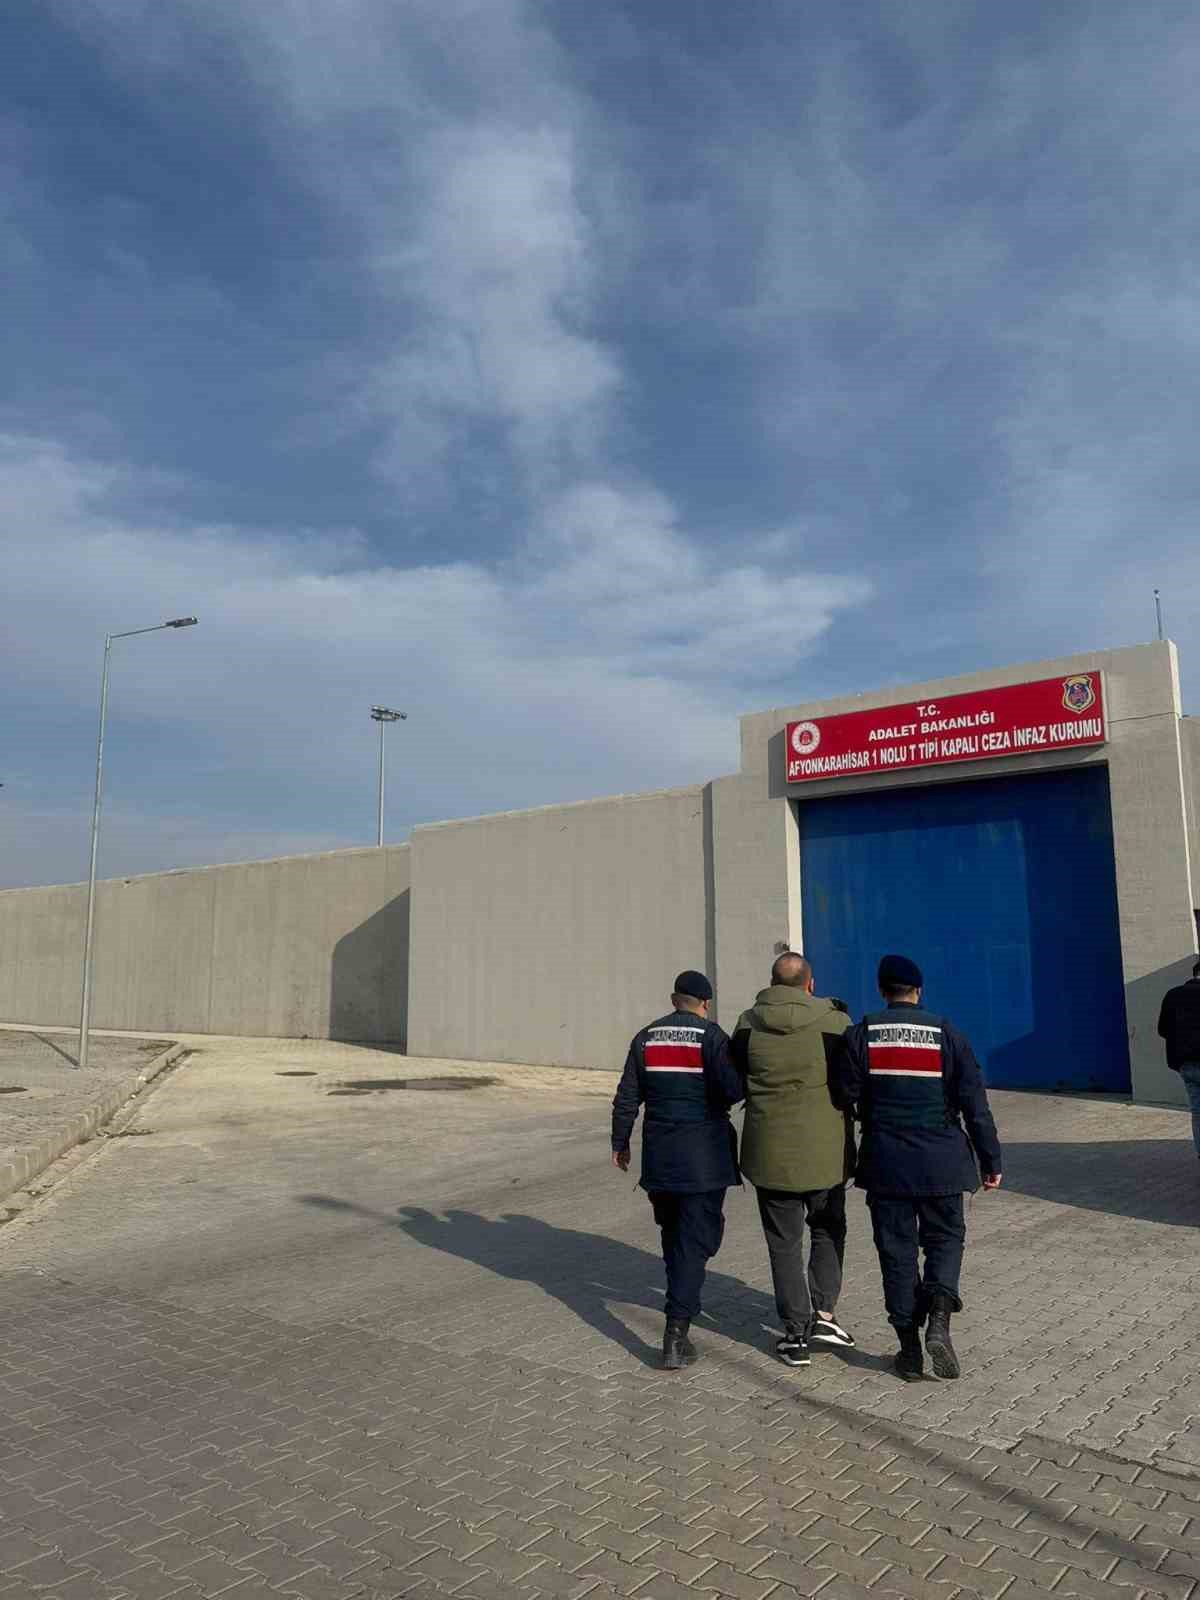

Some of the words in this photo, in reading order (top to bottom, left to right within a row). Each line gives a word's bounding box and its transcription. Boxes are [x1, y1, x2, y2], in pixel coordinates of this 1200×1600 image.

[917, 705, 940, 717] T.C.
[868, 724, 917, 742] ADALET
[921, 711, 995, 733] BAKANLIĞI
[789, 749, 869, 777] AFYONKARAHİSAR
[872, 751, 877, 766] 1
[880, 746, 907, 763] NOLU
[910, 744, 917, 760] T
[918, 738, 938, 759] TİPİ
[941, 737, 979, 757] KAPALI
[982, 731, 1011, 751] CEZA
[1013, 726, 1046, 748] İNFAZ
[1049, 718, 1101, 742] KURUMU
[651, 1030, 696, 1042] JANDARMA
[876, 1029, 935, 1044] JANDARMA
